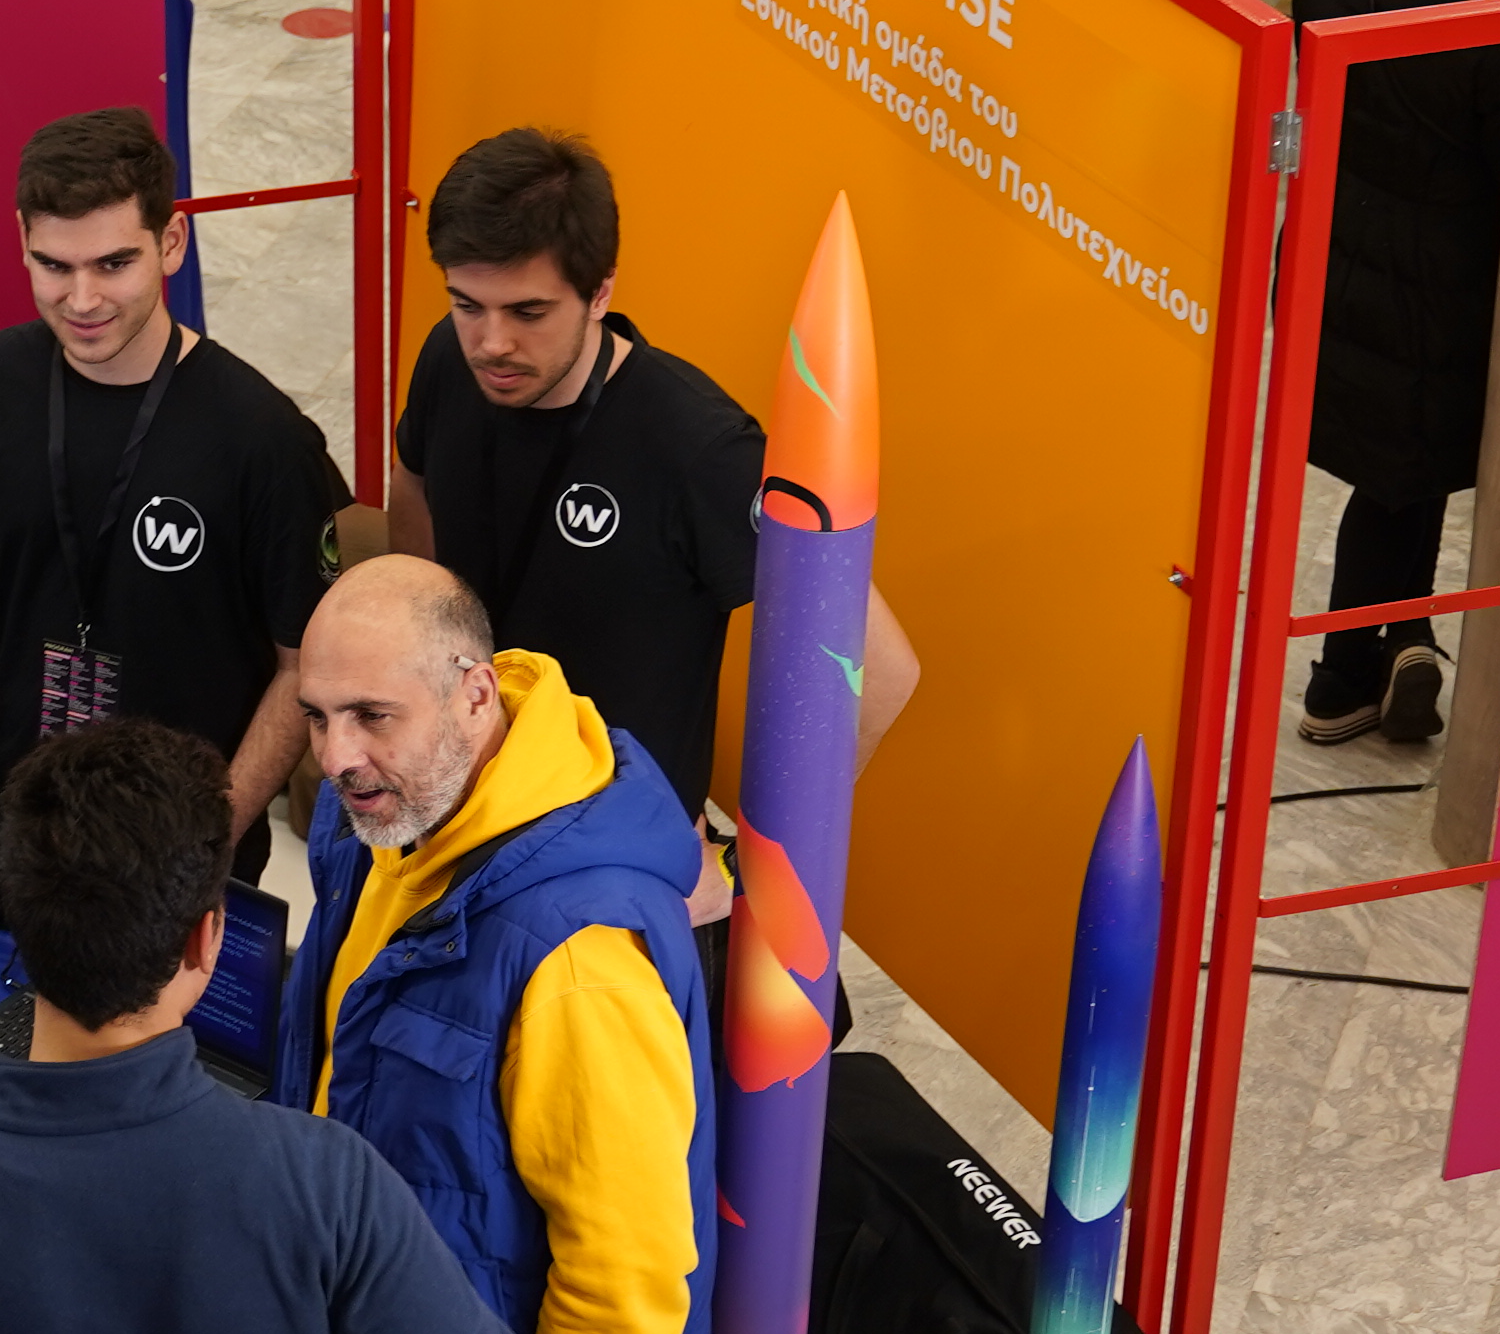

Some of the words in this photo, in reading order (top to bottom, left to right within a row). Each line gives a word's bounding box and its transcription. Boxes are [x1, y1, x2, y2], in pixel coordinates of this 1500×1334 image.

[874, 20, 963, 103] ομάδα
[968, 82, 1018, 138] του
[846, 46, 992, 180] Μετσόβιου
[998, 155, 1209, 335] Πολυτεχνείου
[946, 1158, 1042, 1250] NEEWER
